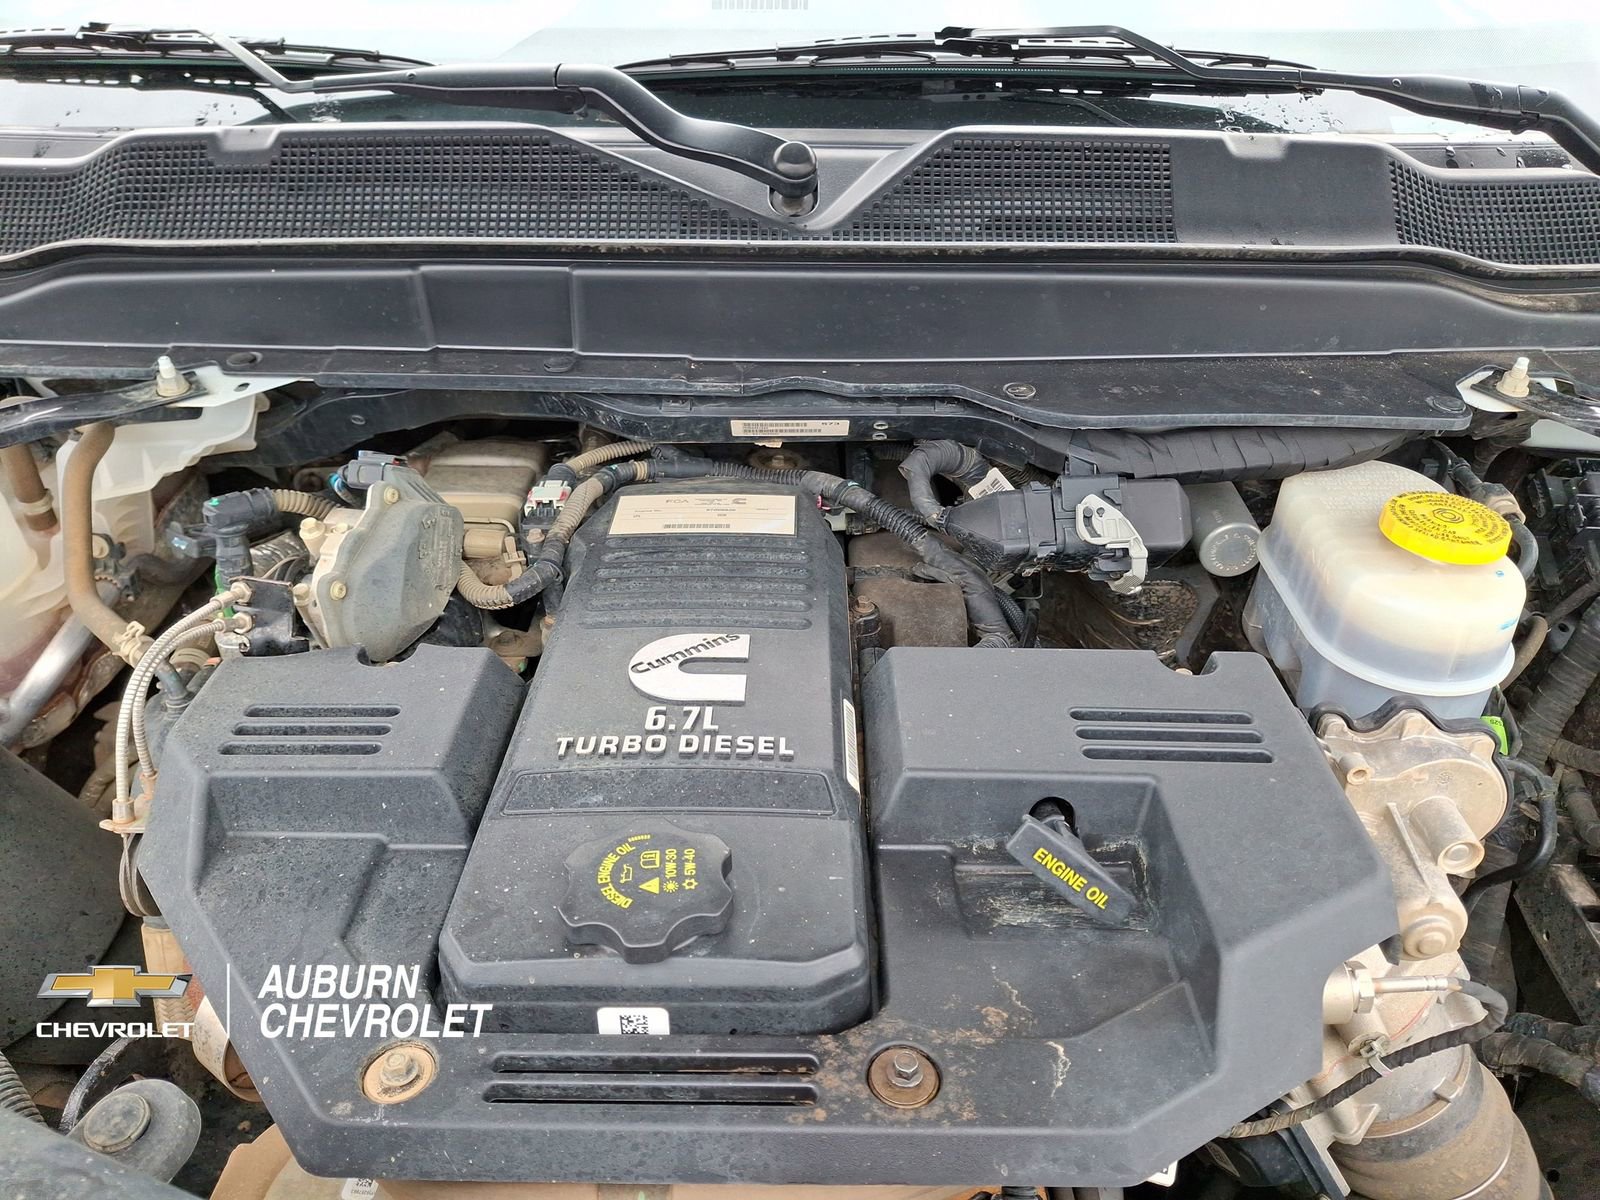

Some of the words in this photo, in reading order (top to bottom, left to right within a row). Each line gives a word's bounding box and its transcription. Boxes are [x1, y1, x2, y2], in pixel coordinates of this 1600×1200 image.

[631, 633, 741, 674] Cummins
[644, 706, 720, 732] 6.7L
[556, 735, 668, 759] TURBO
[678, 734, 794, 760] DIESEL
[616, 842, 636, 856] OIL
[684, 848, 696, 876] 5W-40
[597, 852, 621, 884] ENGINE
[664, 848, 677, 879] 10W-30
[1032, 847, 1088, 892] ENGINE
[1085, 886, 1109, 910] OIL
[600, 883, 633, 909] DIESEL
